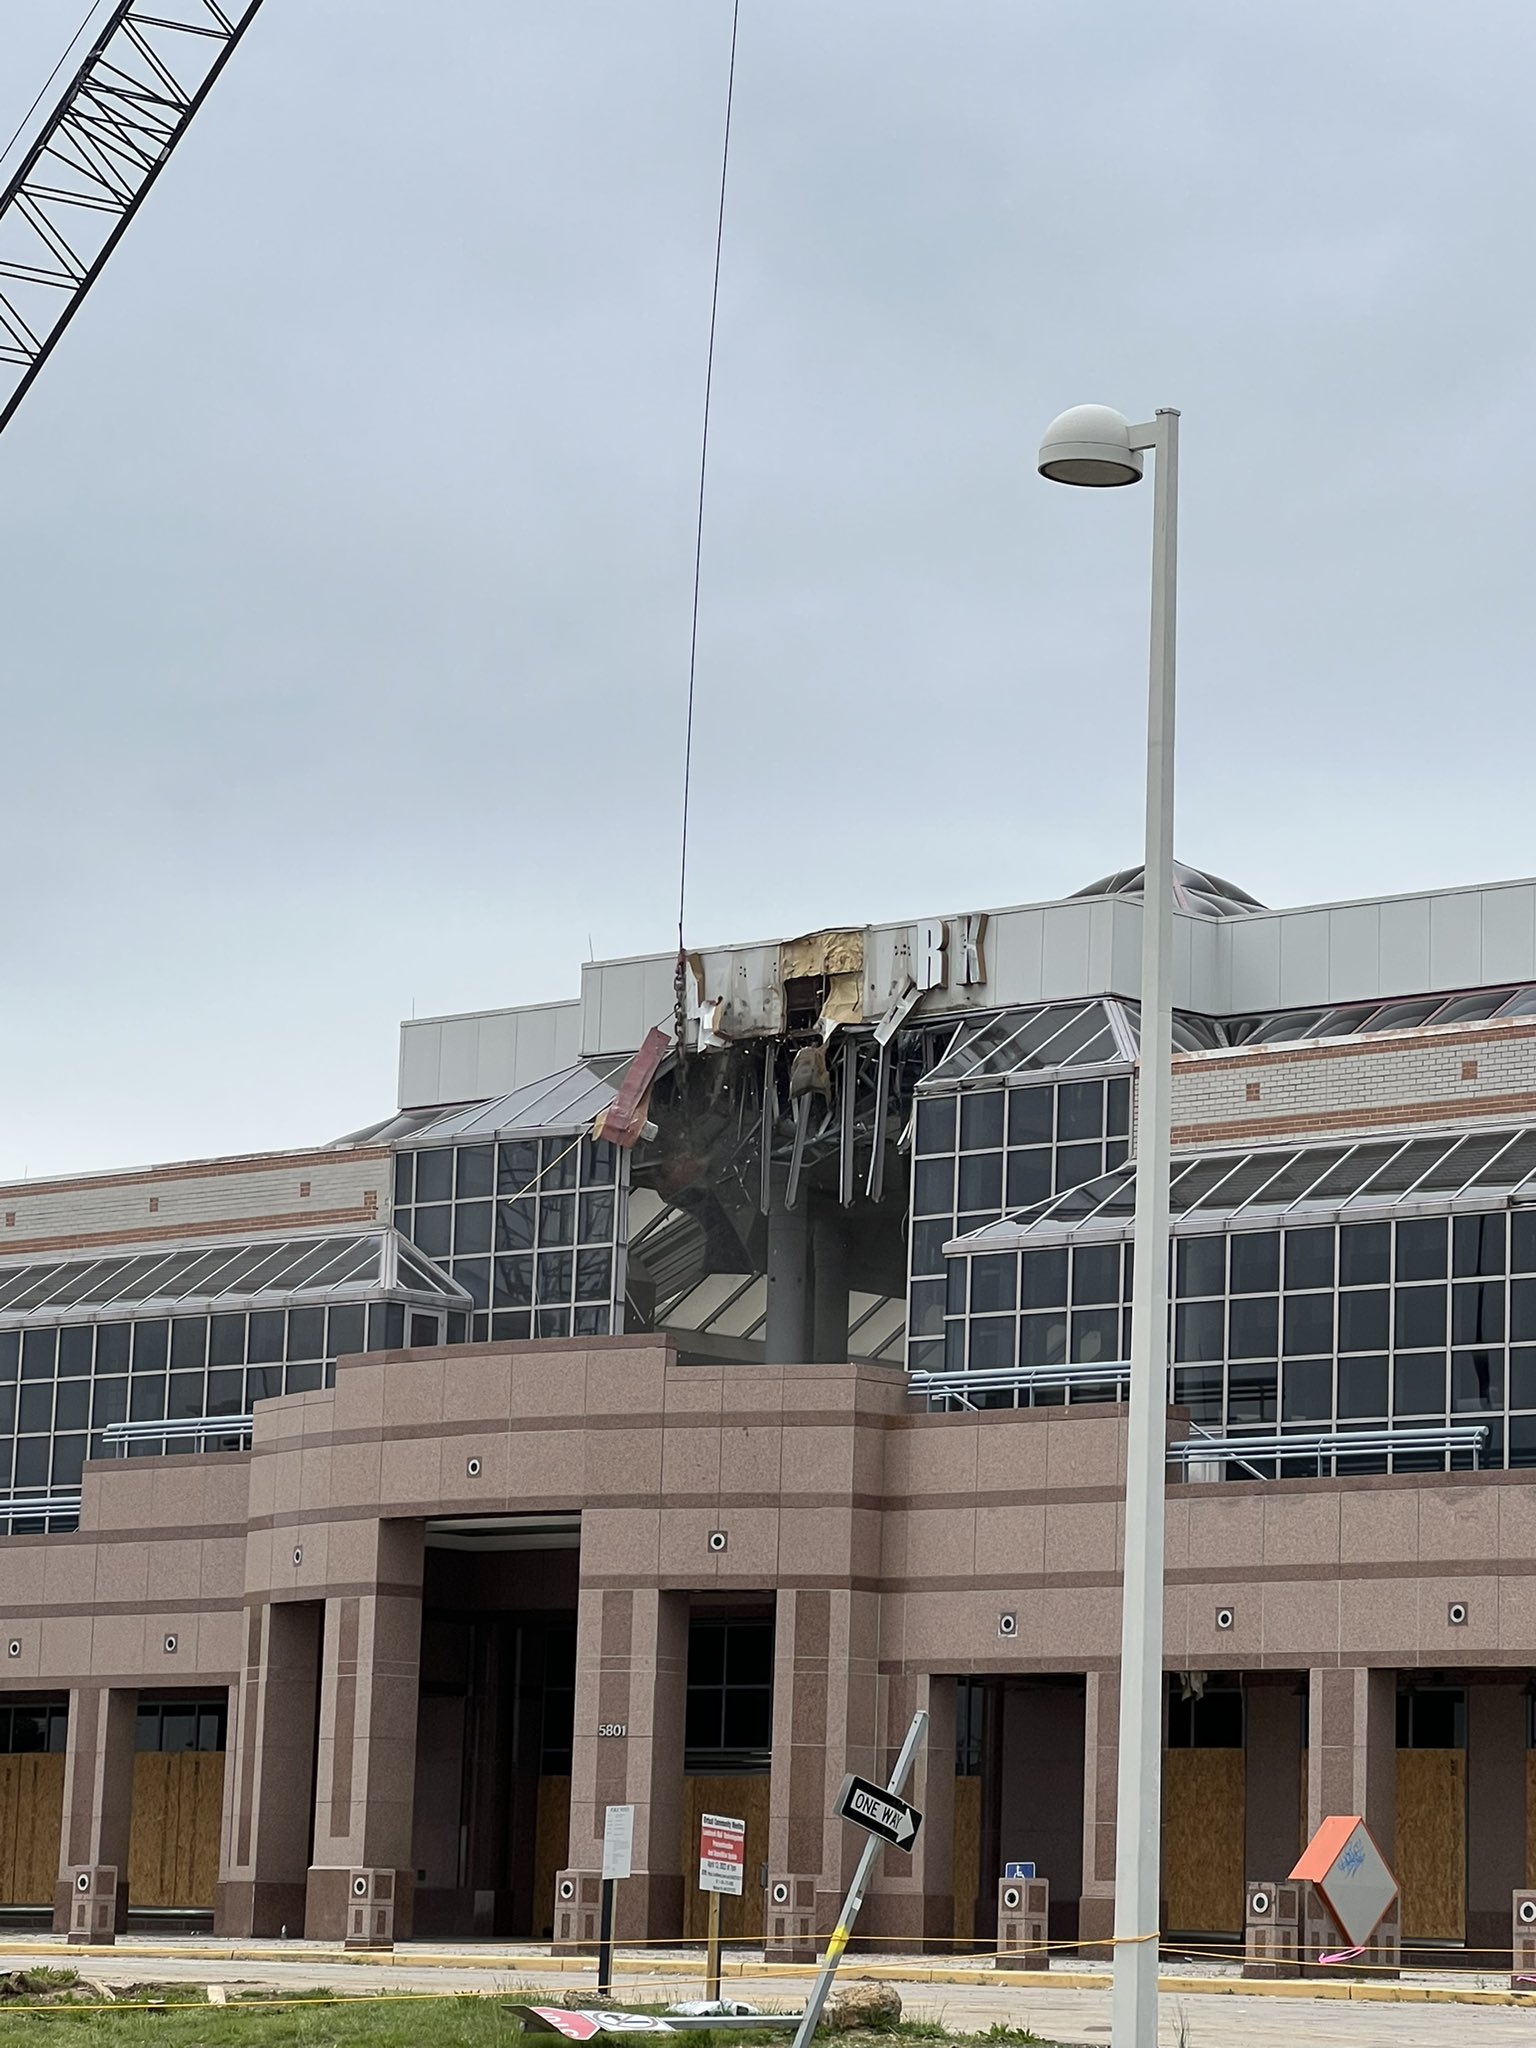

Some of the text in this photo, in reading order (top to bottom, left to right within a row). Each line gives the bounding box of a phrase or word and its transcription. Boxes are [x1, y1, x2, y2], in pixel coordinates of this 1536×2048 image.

[598, 1723, 626, 1737] 5801
[855, 1793, 904, 1830] ONE WAY
